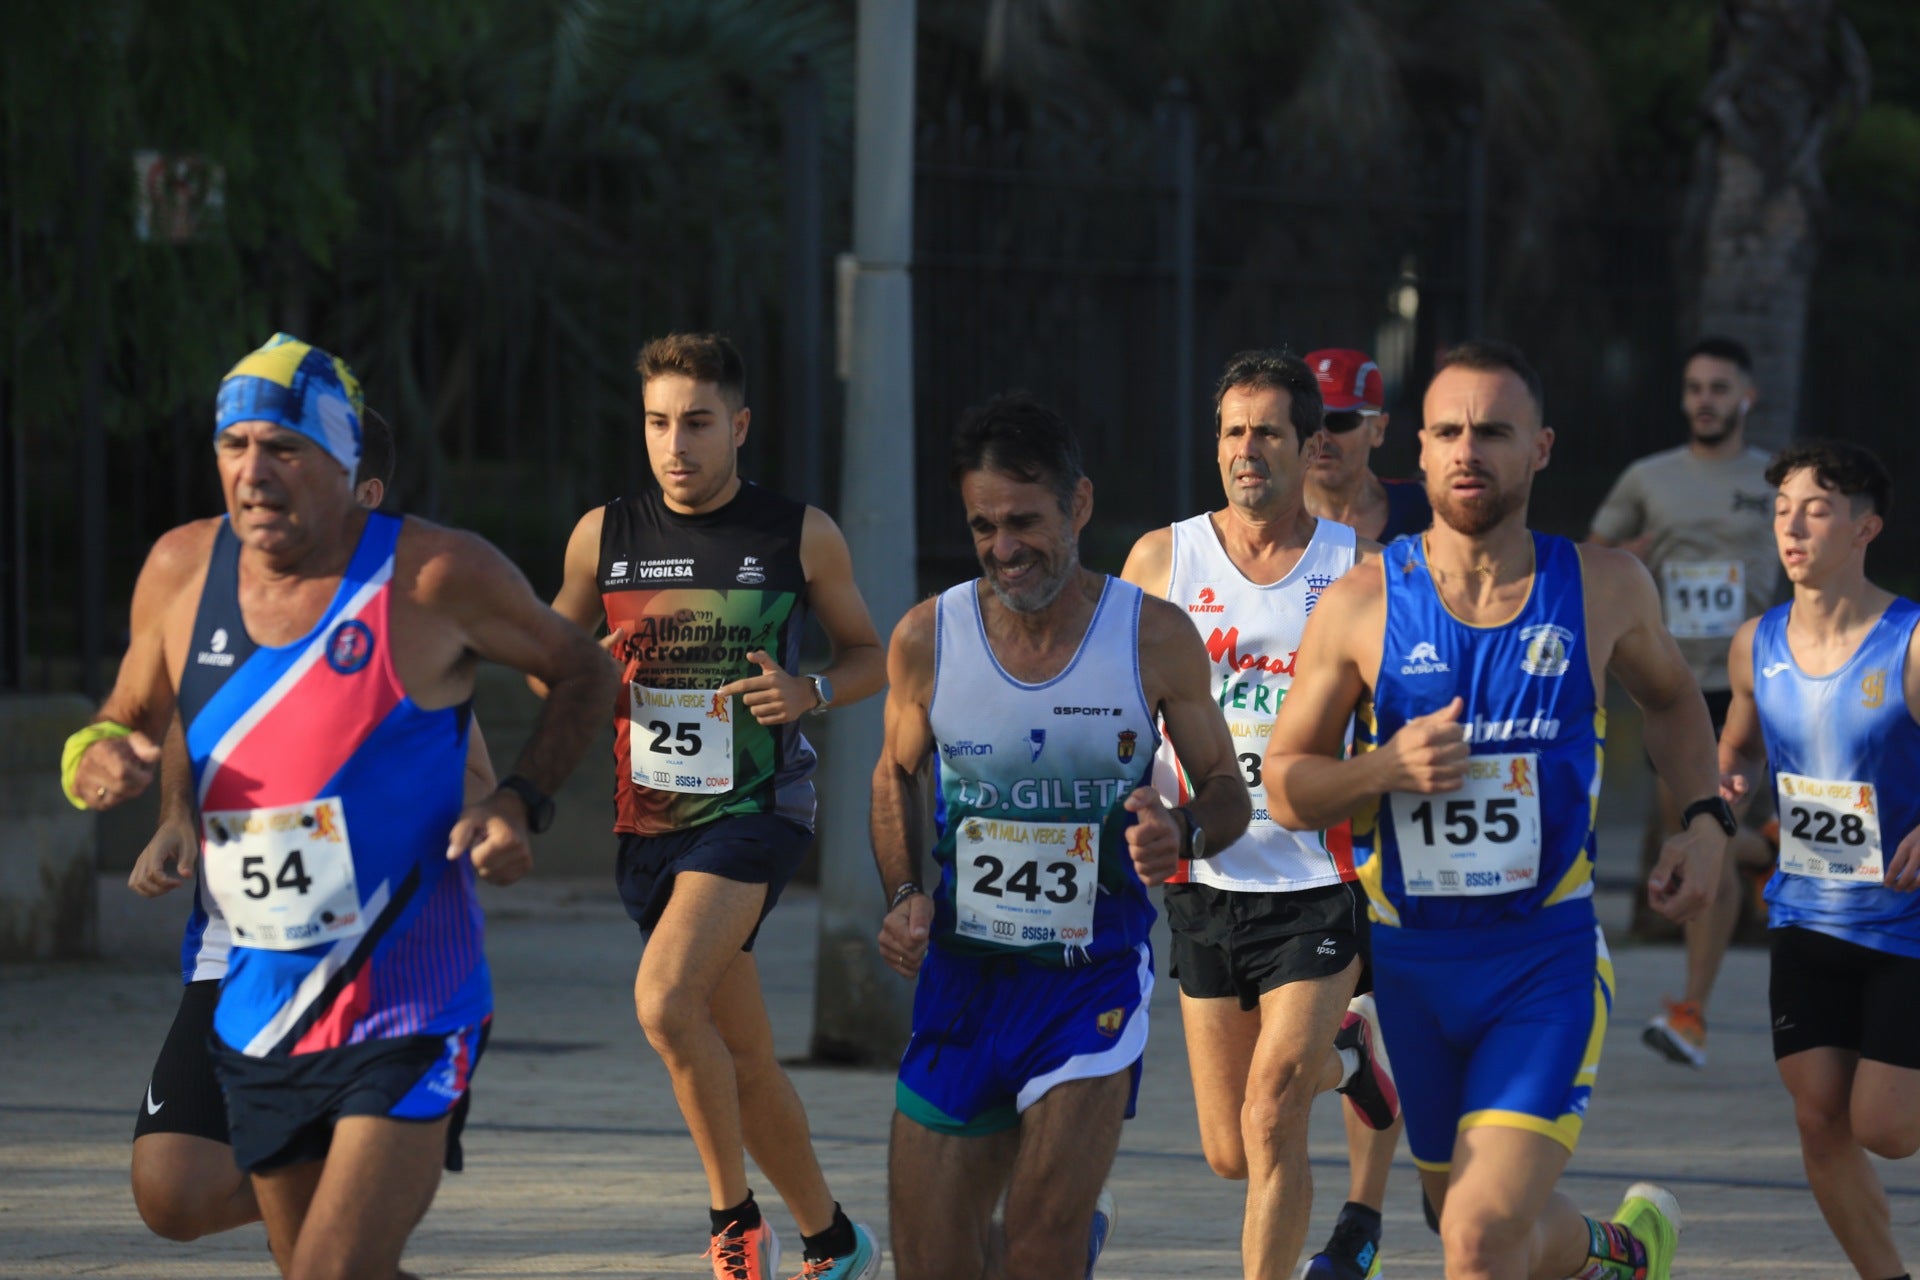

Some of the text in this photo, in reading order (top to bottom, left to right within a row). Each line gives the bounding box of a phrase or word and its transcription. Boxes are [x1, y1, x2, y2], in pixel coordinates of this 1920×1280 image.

[640, 566, 693, 579] VIGILSA
[647, 559, 666, 567] GRAN
[1188, 605, 1225, 613] VIATOR
[1677, 585, 1734, 613] 110
[630, 616, 753, 648] Alhambra
[677, 693, 705, 708] VERDE
[649, 720, 702, 757] 25
[706, 777, 730, 787] COVAP
[1411, 798, 1520, 847] 155
[1791, 806, 1866, 846] 228
[1000, 823, 1030, 845] MILLA
[1032, 827, 1066, 845] VERDE
[241, 850, 313, 899] 54
[973, 855, 1079, 904] 243
[1022, 926, 1049, 940] asisa
[1060, 927, 1089, 940] COVAP
